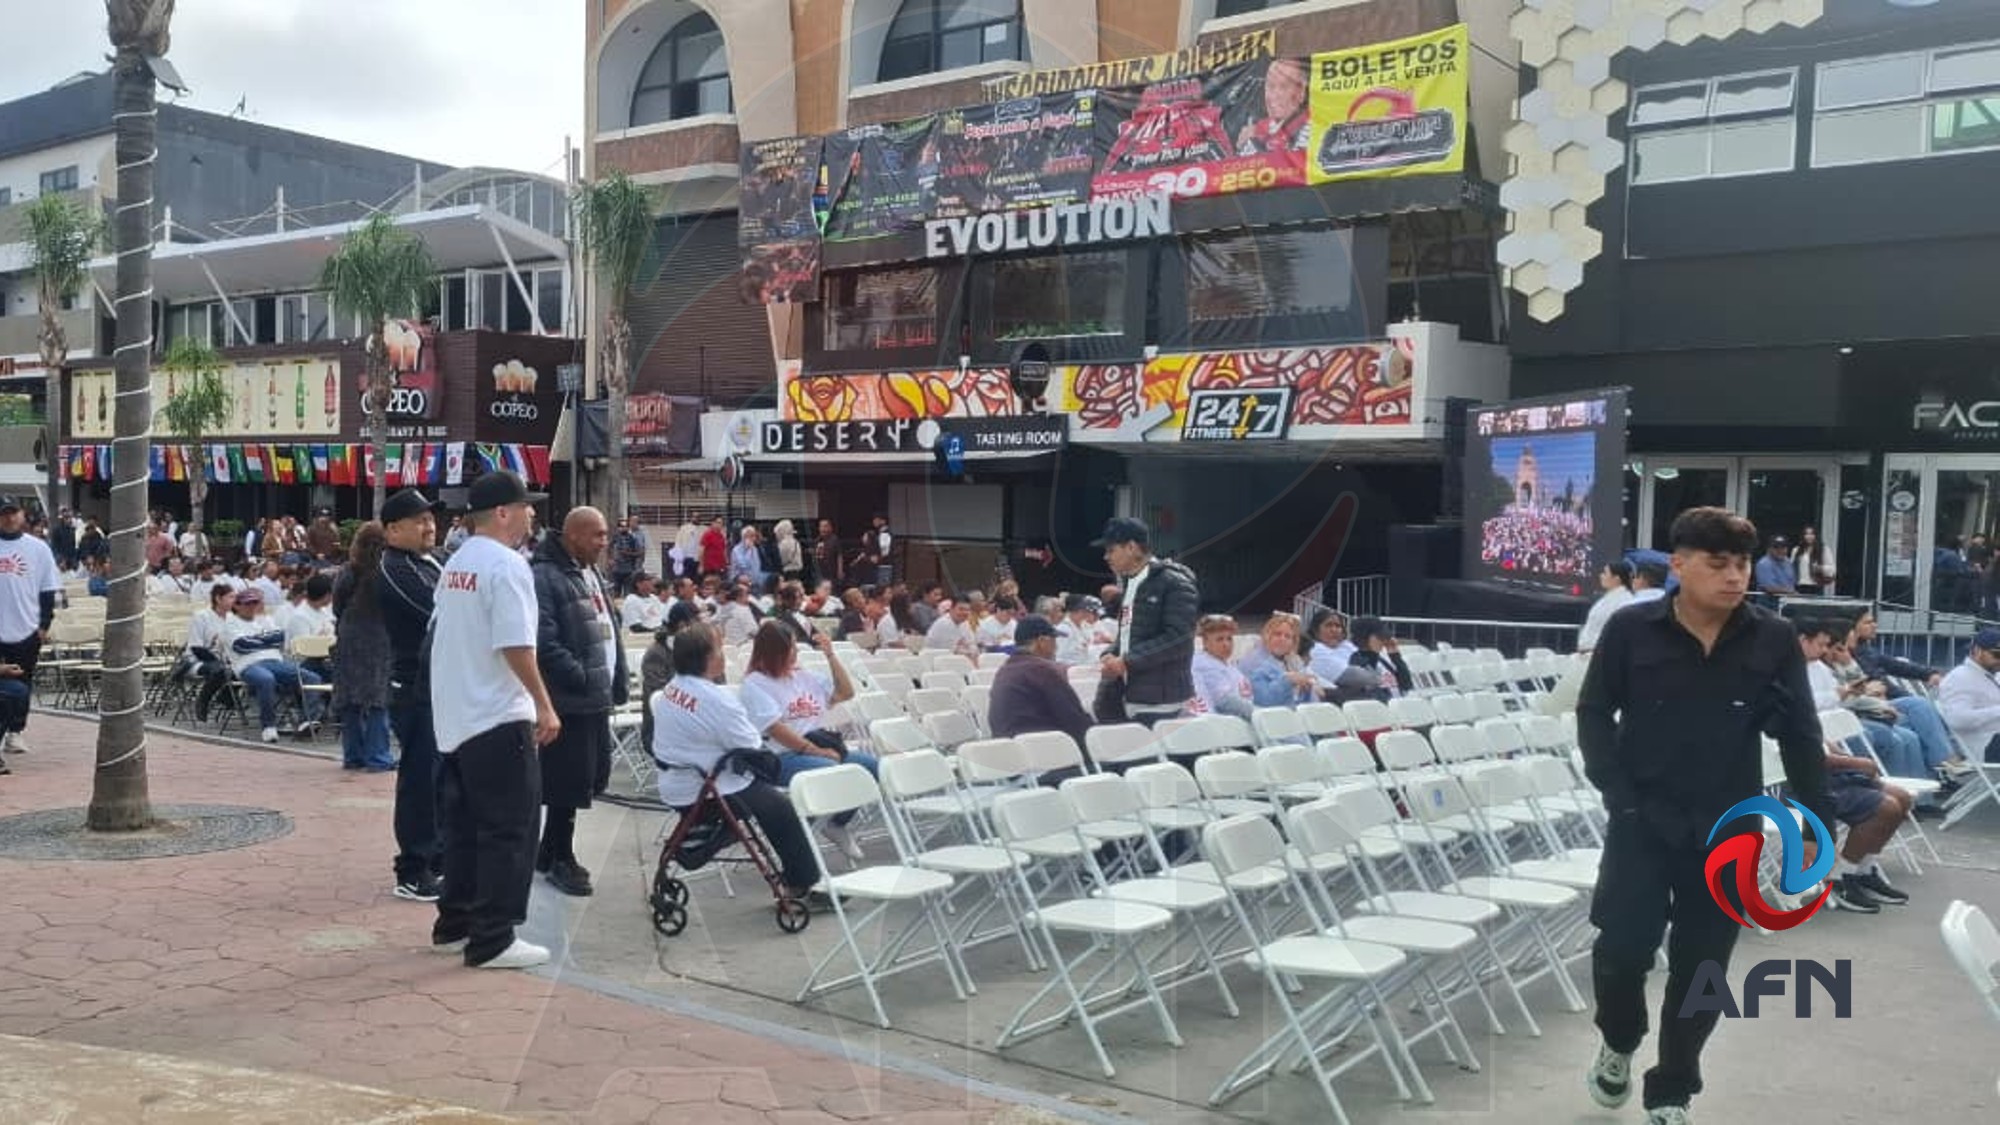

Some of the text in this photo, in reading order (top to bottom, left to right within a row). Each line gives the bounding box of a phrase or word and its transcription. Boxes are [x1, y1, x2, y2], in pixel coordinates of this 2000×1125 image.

[1321, 40, 1457, 80] BOLETOS
[1364, 76, 1374, 86] A
[1380, 71, 1397, 84] LA
[1404, 60, 1457, 79] VENTA
[1147, 167, 1207, 198] 30
[924, 191, 1172, 257] EVOLUTION
[360, 388, 425, 414] CPEO
[976, 430, 1062, 445] TASTING ROOM
[1184, 428, 1234, 439] FITNESS
